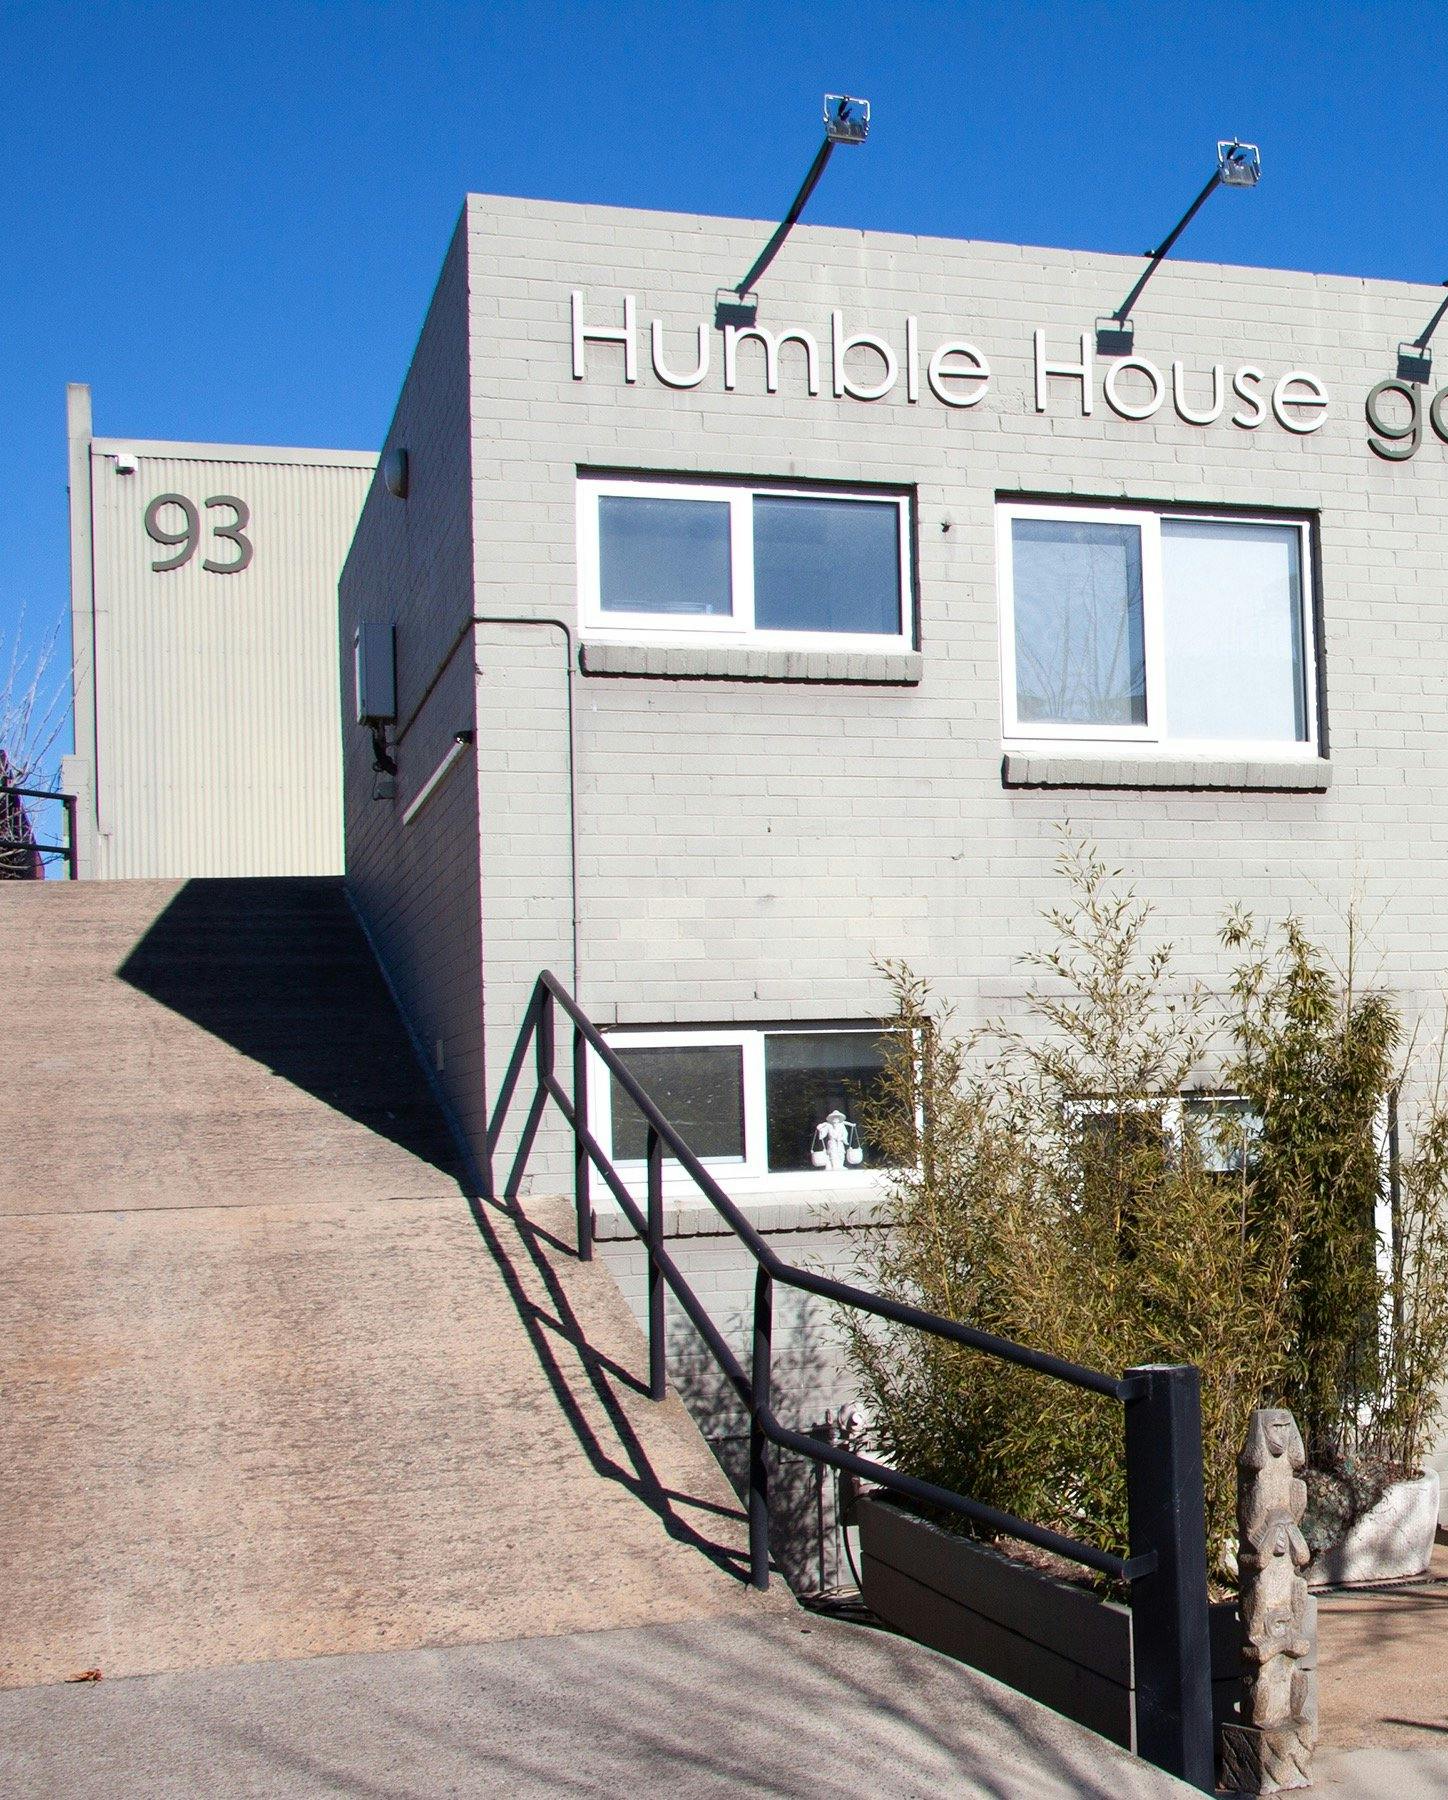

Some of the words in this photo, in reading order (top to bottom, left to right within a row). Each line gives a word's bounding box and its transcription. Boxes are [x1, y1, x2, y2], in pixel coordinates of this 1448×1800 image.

[571, 290, 991, 408] Humble
[1034, 328, 1330, 436] House
[144, 493, 254, 575] 93
